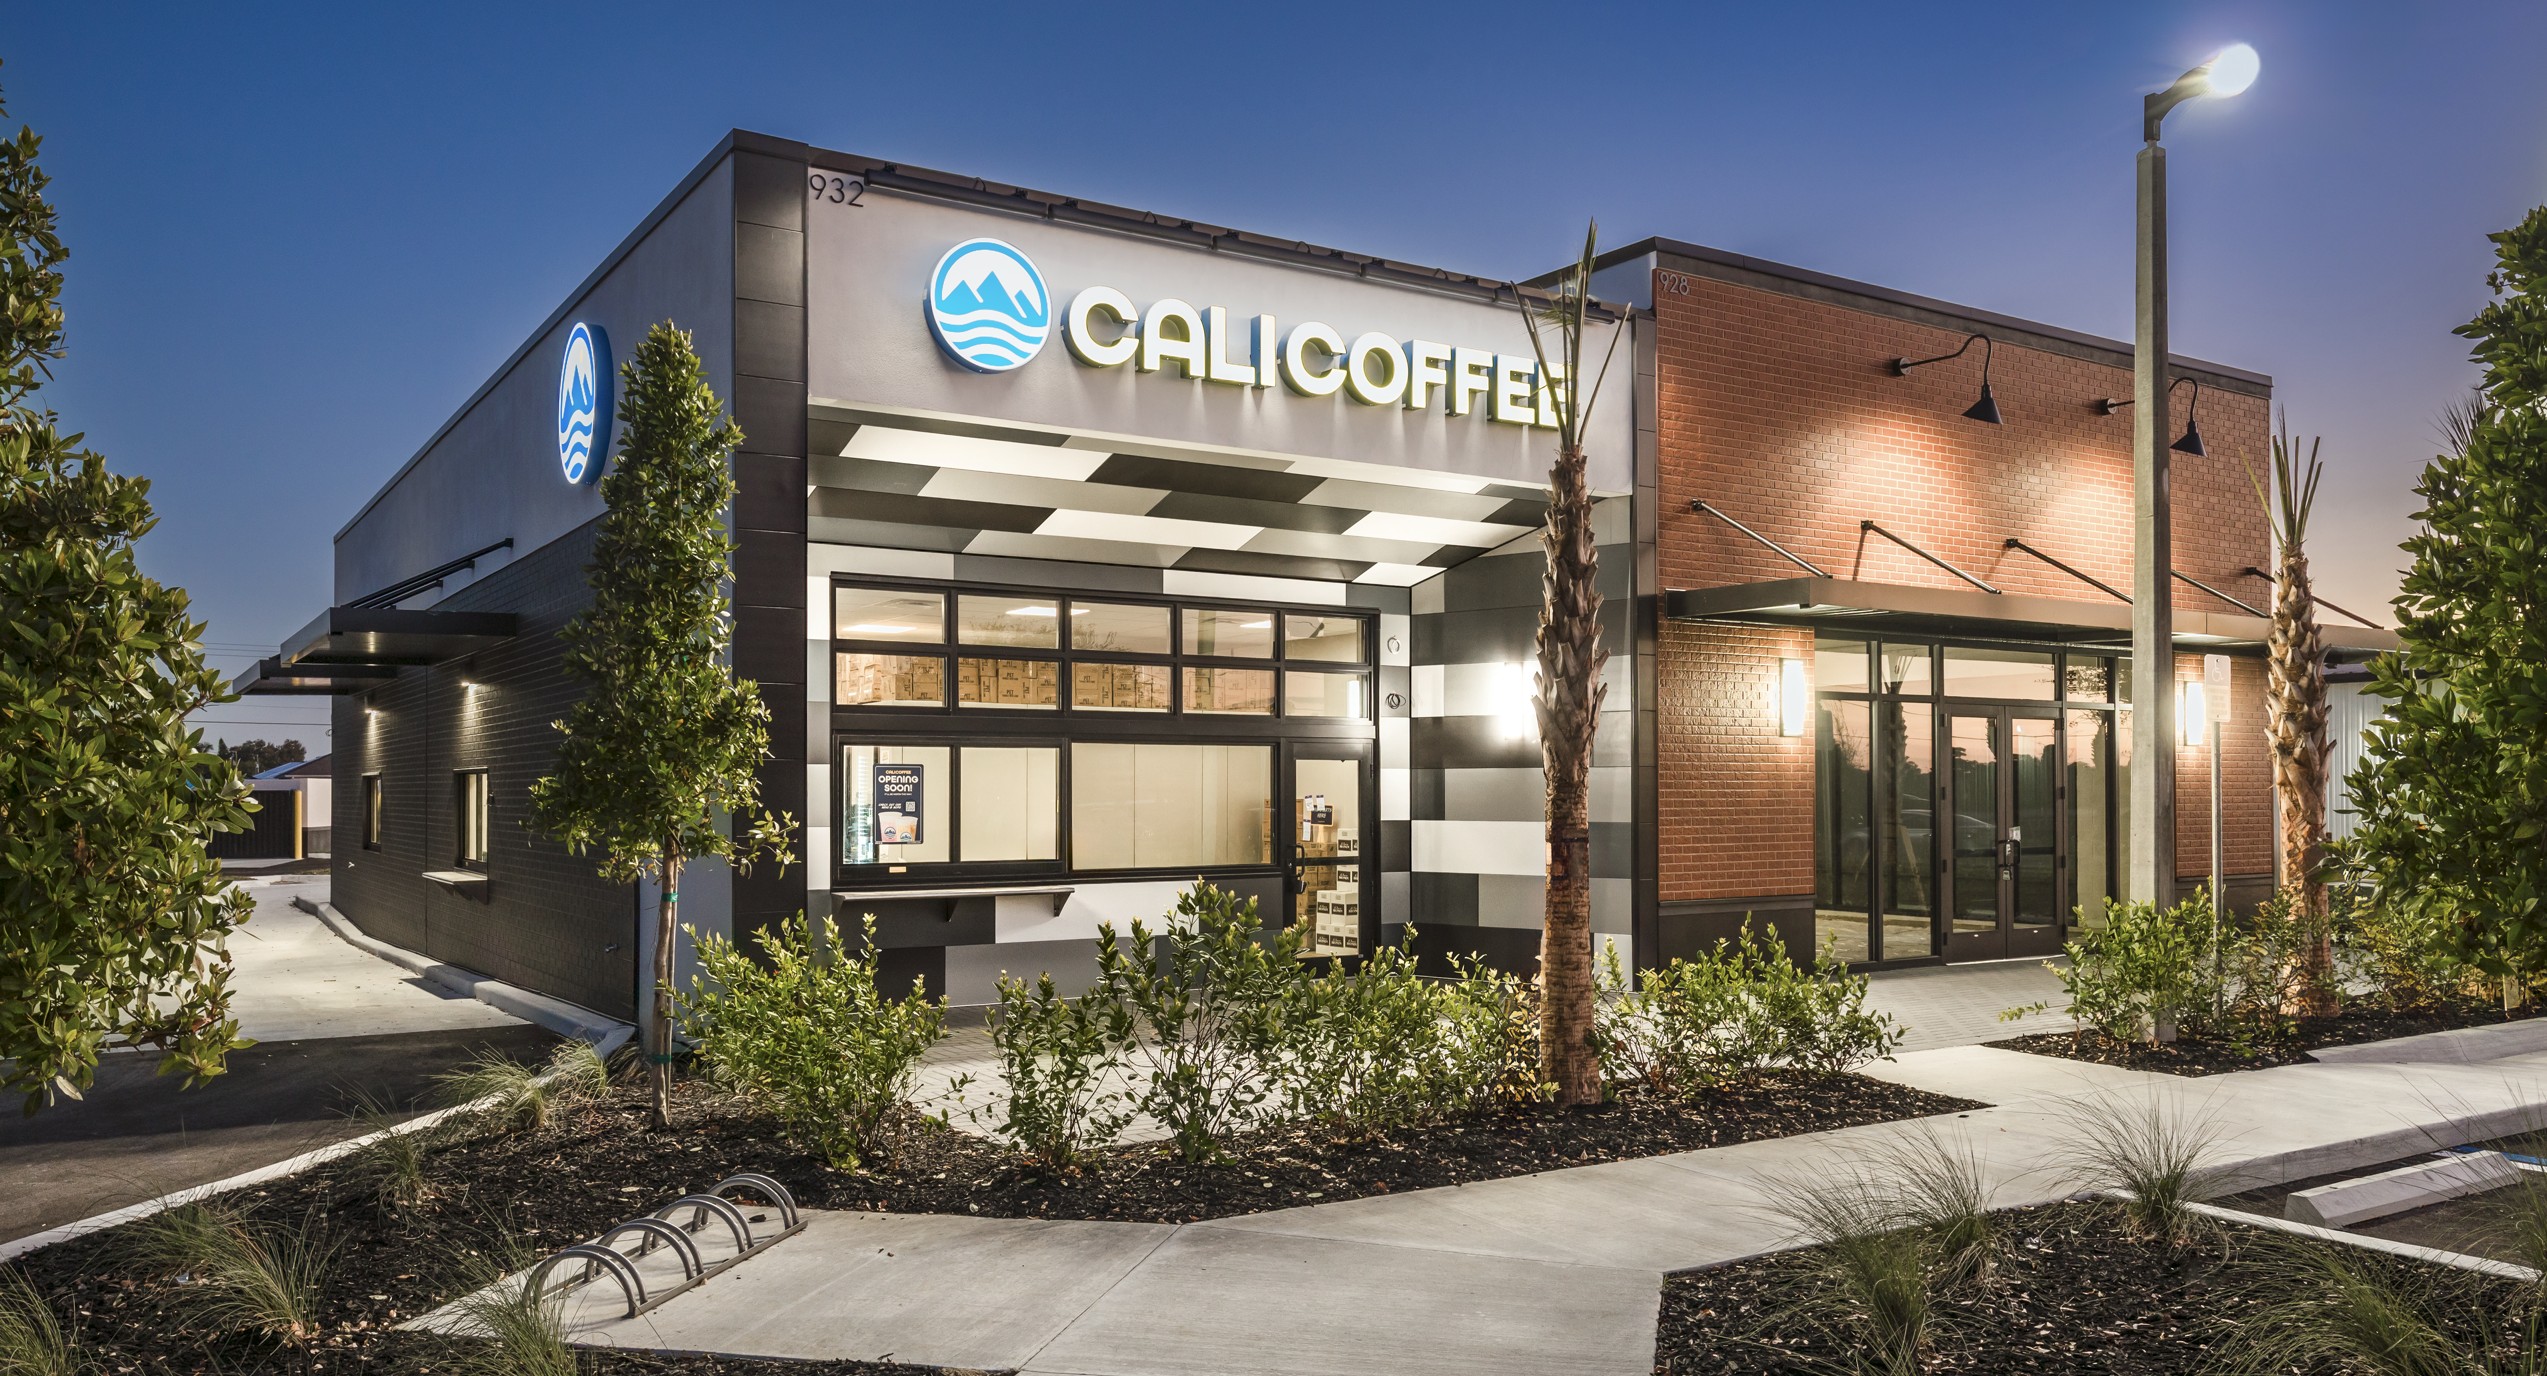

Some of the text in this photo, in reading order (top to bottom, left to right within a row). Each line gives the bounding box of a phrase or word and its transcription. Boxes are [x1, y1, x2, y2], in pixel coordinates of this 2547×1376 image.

[810, 174, 864, 208] 932
[1660, 271, 1689, 296] 928
[1062, 285, 1573, 430] CALICOFFEE
[878, 775, 919, 784] OPENING
[884, 784, 913, 792] SOON!
